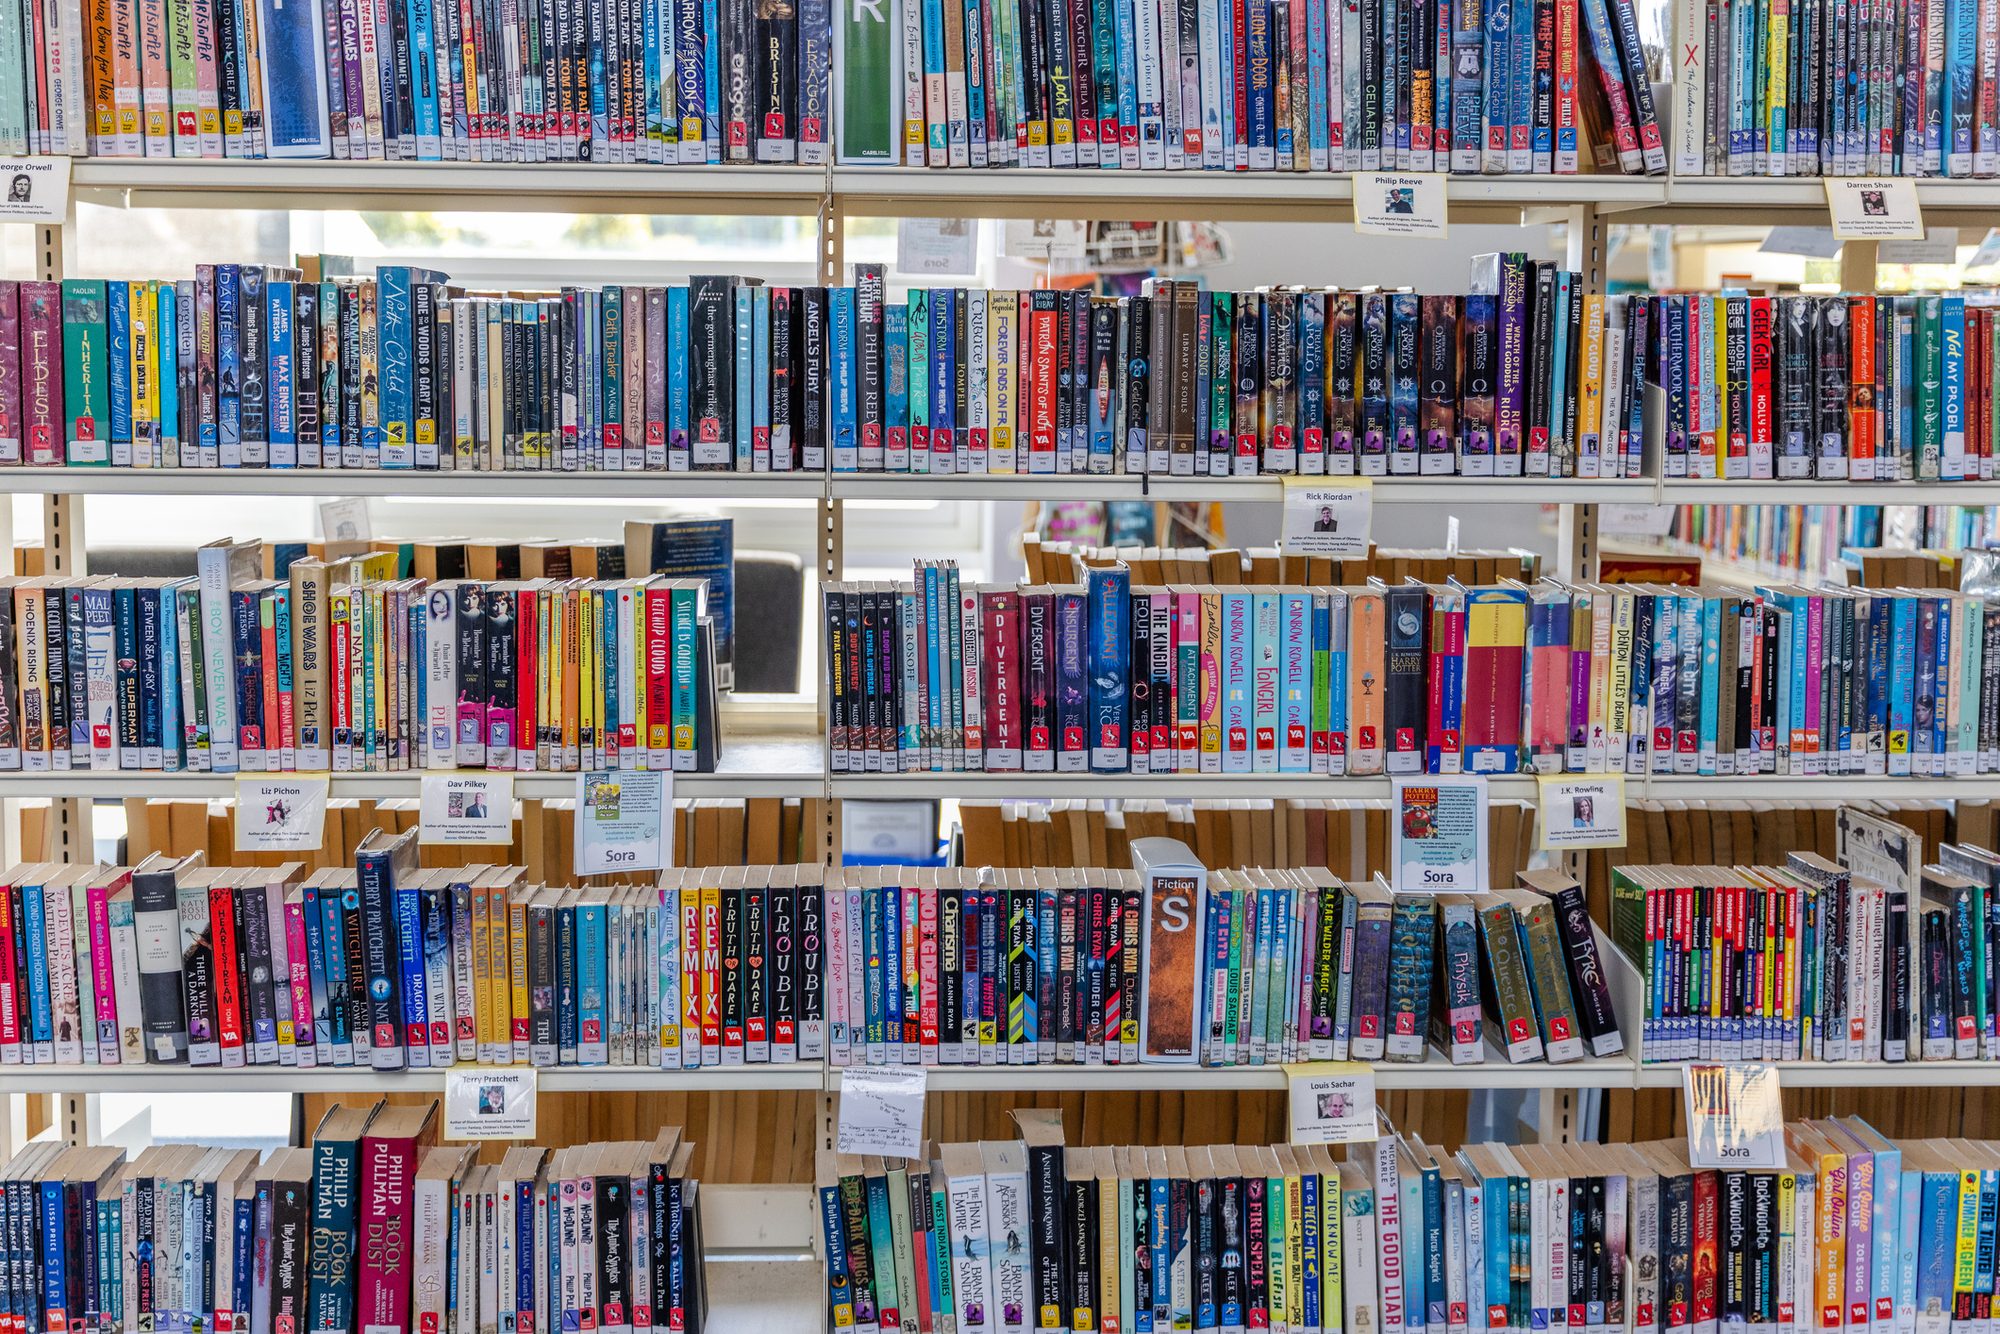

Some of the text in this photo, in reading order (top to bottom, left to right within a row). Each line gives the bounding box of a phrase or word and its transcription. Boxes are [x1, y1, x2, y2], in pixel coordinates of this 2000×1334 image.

[94, 27, 114, 101] Born for This
[343, 22, 358, 61] GAMES
[397, 40, 407, 84] DRUMMER
[544, 22, 555, 86] SIDE TOM
[1054, 32, 1062, 60] RALPH
[1561, 50, 1572, 73] MOON
[1984, 39, 1994, 78] SHAN
[226, 62, 234, 92] GRIEF
[683, 59, 696, 100] MOON
[1364, 20, 1376, 117] not forgiveness CELIA
[1562, 98, 1572, 126] PHILIP
[1375, 177, 1397, 185] Philip
[859, 276, 872, 323] ARTHUR
[873, 277, 881, 300] HERE
[1572, 284, 1581, 324] THE ENEMY
[179, 295, 191, 356] forgotten
[247, 305, 256, 361] James Patterson
[384, 274, 407, 394] North Child
[417, 287, 430, 404] GONE WOODS GARY
[703, 305, 715, 386] the gormenghast
[780, 320, 788, 357] RAISING
[808, 301, 819, 394] ANGEL'S FURY
[865, 334, 877, 385] PHILIP
[1181, 372, 1188, 383] OF
[1513, 354, 1520, 364] OF
[1728, 335, 1736, 372] MISFIT
[1736, 335, 1744, 373] MODEL
[1945, 329, 1961, 382] Not MY
[280, 355, 289, 432] MAX EINSTEIN
[299, 392, 317, 442] FIRE
[26, 598, 37, 682] PHOENIX RISING
[302, 581, 316, 670] SHOE WARS
[651, 598, 666, 674] KETCHUP CLOUDS
[905, 604, 914, 680] MEG ROSOFF
[1031, 607, 1044, 674] DIVERGENT
[1137, 599, 1148, 639] FOUR
[1230, 599, 1244, 684] RAINBOW ROWELL
[353, 636, 363, 676] NATE
[965, 615, 976, 698] THE SOTERION MISSION
[1154, 608, 1168, 683] THE KINGDOM
[1615, 630, 1627, 698] DENTON LITTLE'S
[996, 615, 1008, 749] DIVERGENT
[1188, 649, 1196, 716] ATTACHMENTS
[127, 678, 136, 743] SUPERMAN
[464, 781, 487, 789] Pilkey
[1574, 786, 1603, 794] Rowling
[606, 850, 635, 862] Sora
[1424, 870, 1454, 882] Sora
[1157, 880, 1194, 889] Fiction
[95, 900, 103, 921] kiss
[364, 873, 384, 975] TERRY PRATCHETT
[943, 897, 958, 972] Charisma
[1160, 896, 1189, 932] S
[98, 947, 106, 967] love
[348, 914, 363, 991] WITCH FIRE
[99, 970, 107, 990] hate
[1091, 972, 1099, 1006] UNDER
[1228, 968, 1238, 1034] LOUIS SACHAR
[1454, 952, 1468, 1003] Physik
[463, 1076, 482, 1084] Terry
[1311, 1080, 1355, 1090] Louis Sachar
[1380, 1150, 1388, 1183] SEARLE
[1720, 1145, 1750, 1157] Sora
[318, 1147, 333, 1218] PULLMAN
[334, 1158, 348, 1207] PHILIP
[372, 1144, 388, 1215] PULLMAN
[388, 1155, 402, 1204] PHILIP
[953, 1193, 967, 1231] EMPIRE
[969, 1200, 982, 1232] FINAL
[367, 1223, 381, 1271] DUST
[937, 1226, 946, 1258] INDIAN
[1382, 1193, 1401, 1325] THE GOOD LIAR
[1959, 1193, 1976, 1286] SUMMER GREEN
[940, 1261, 949, 1296] STORIES
[1855, 1244, 1865, 1292] ZOE SUGG
